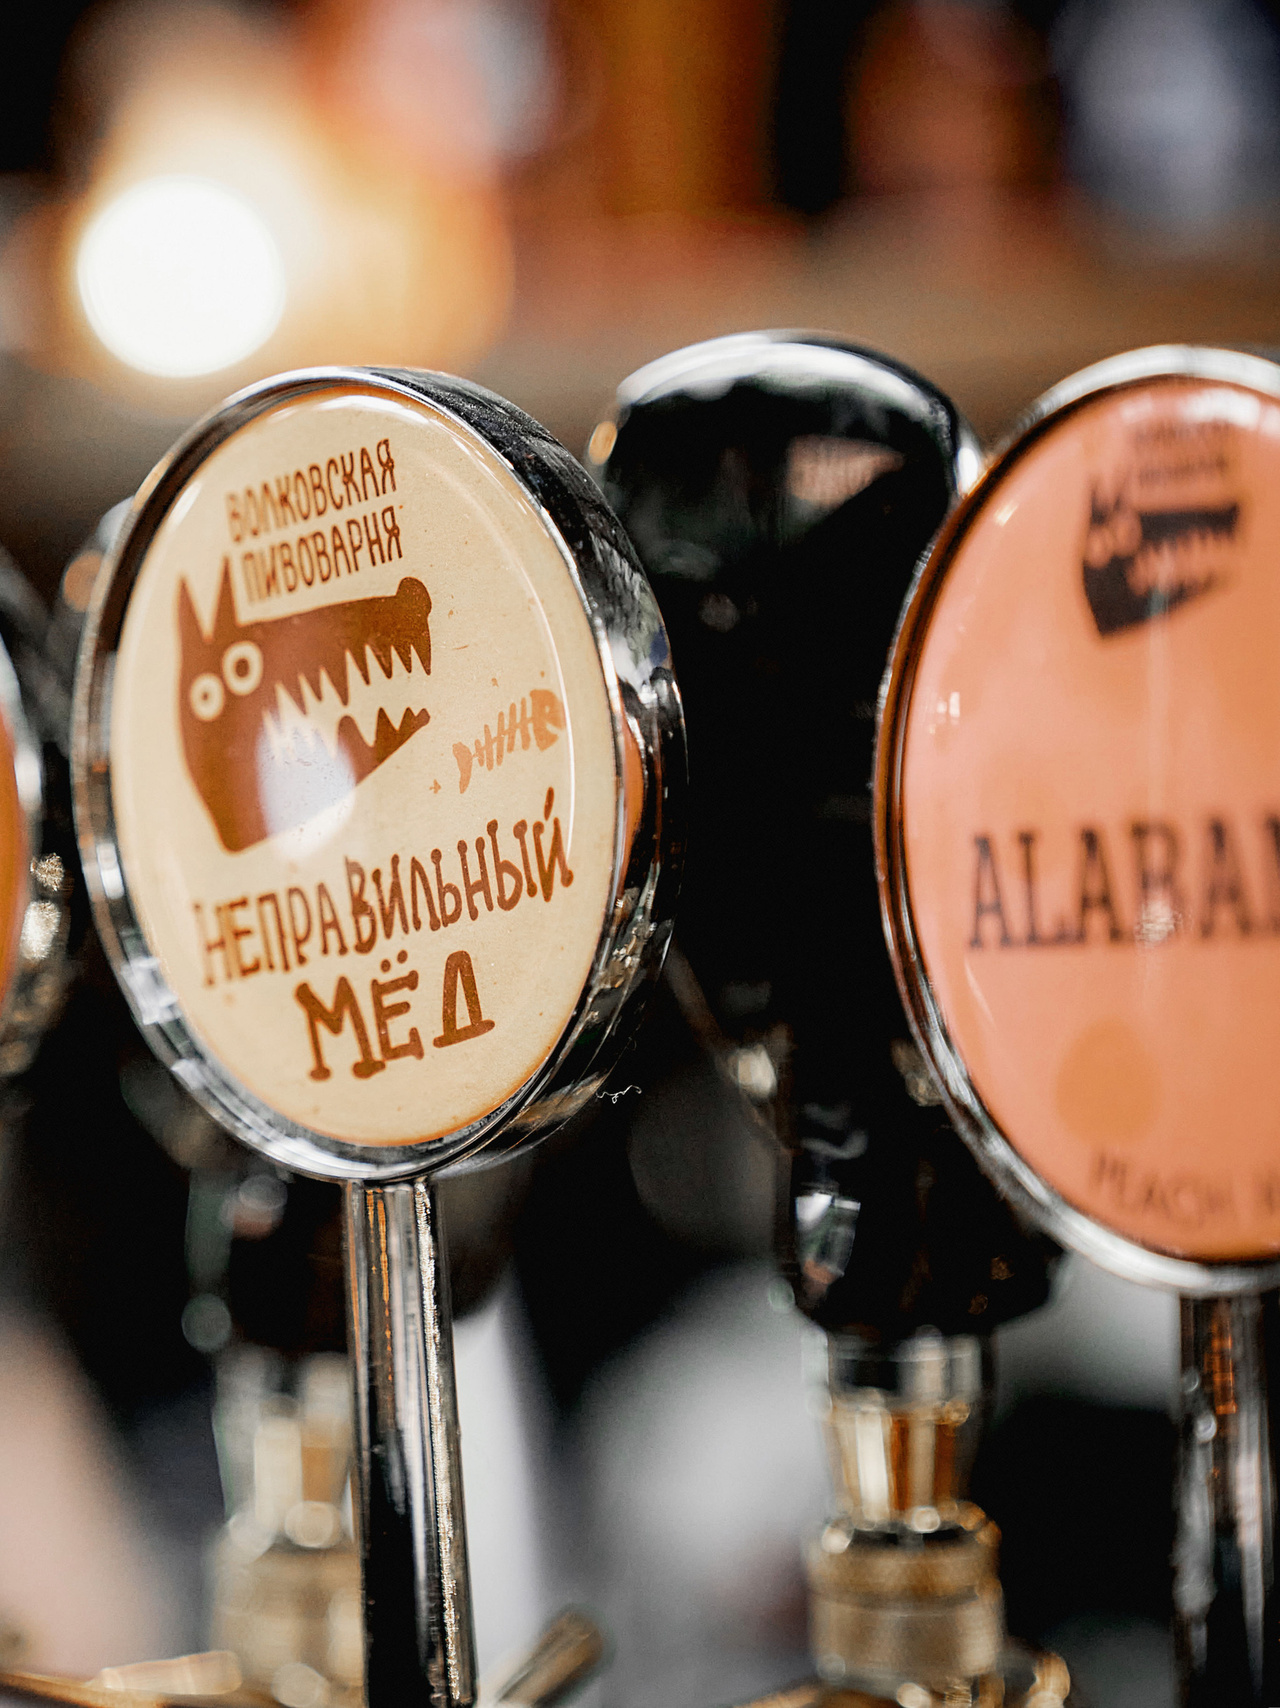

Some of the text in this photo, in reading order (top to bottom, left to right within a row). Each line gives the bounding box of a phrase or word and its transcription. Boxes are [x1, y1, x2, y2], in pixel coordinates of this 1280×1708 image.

[226, 438, 397, 543] ВОЛКОВСКАЯ
[241, 504, 403, 605] ПИВОВАРНЯ
[193, 787, 574, 987] НЕПРАВИЛЬНЫЙ
[294, 950, 496, 1081] МЁД
